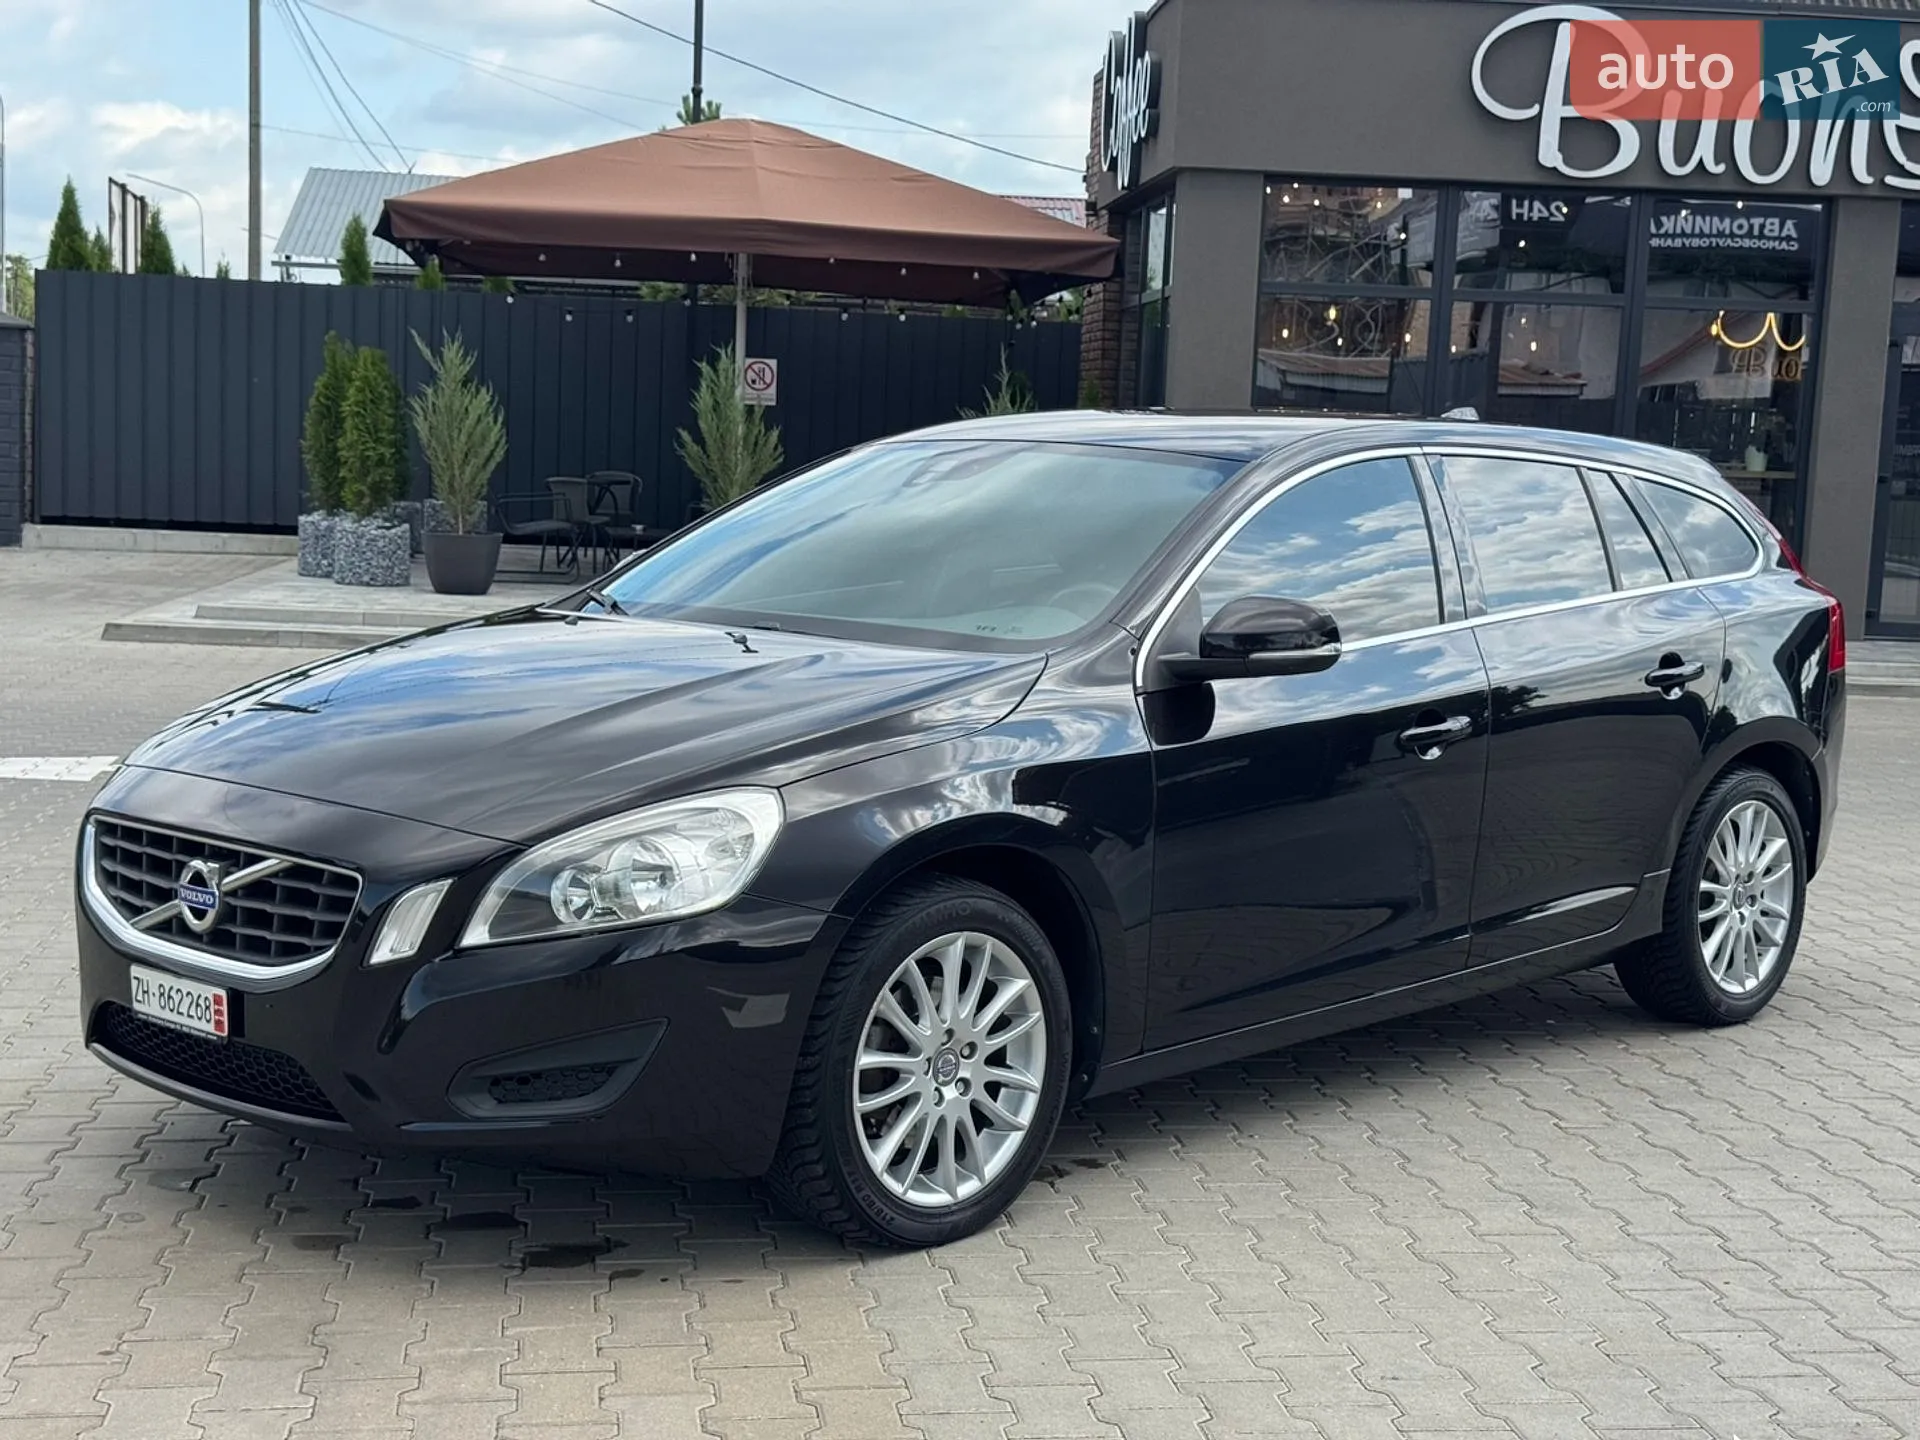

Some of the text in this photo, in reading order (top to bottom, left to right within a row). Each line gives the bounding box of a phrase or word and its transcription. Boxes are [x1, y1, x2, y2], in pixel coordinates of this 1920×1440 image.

[1101, 11, 1151, 191] Coffee
[1730, 345, 1807, 382] Buo
[180, 887, 214, 905] VOLVO
